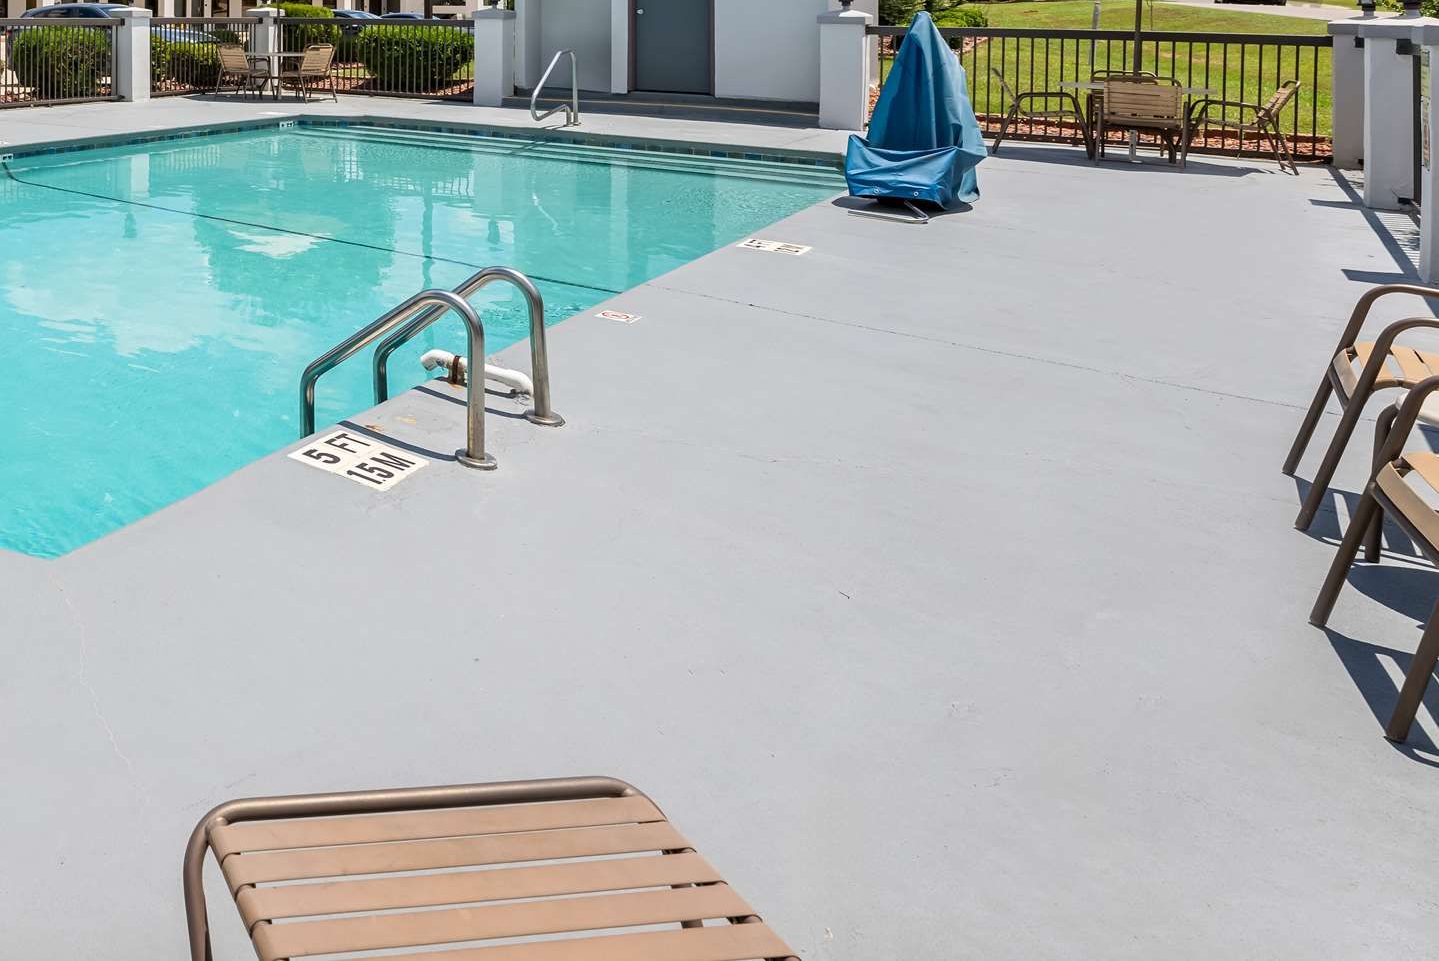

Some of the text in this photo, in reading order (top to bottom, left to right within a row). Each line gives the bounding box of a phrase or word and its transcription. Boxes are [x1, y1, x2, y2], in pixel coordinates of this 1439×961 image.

[302, 432, 372, 464] 5 FT
[346, 451, 416, 485] 1.5 M
